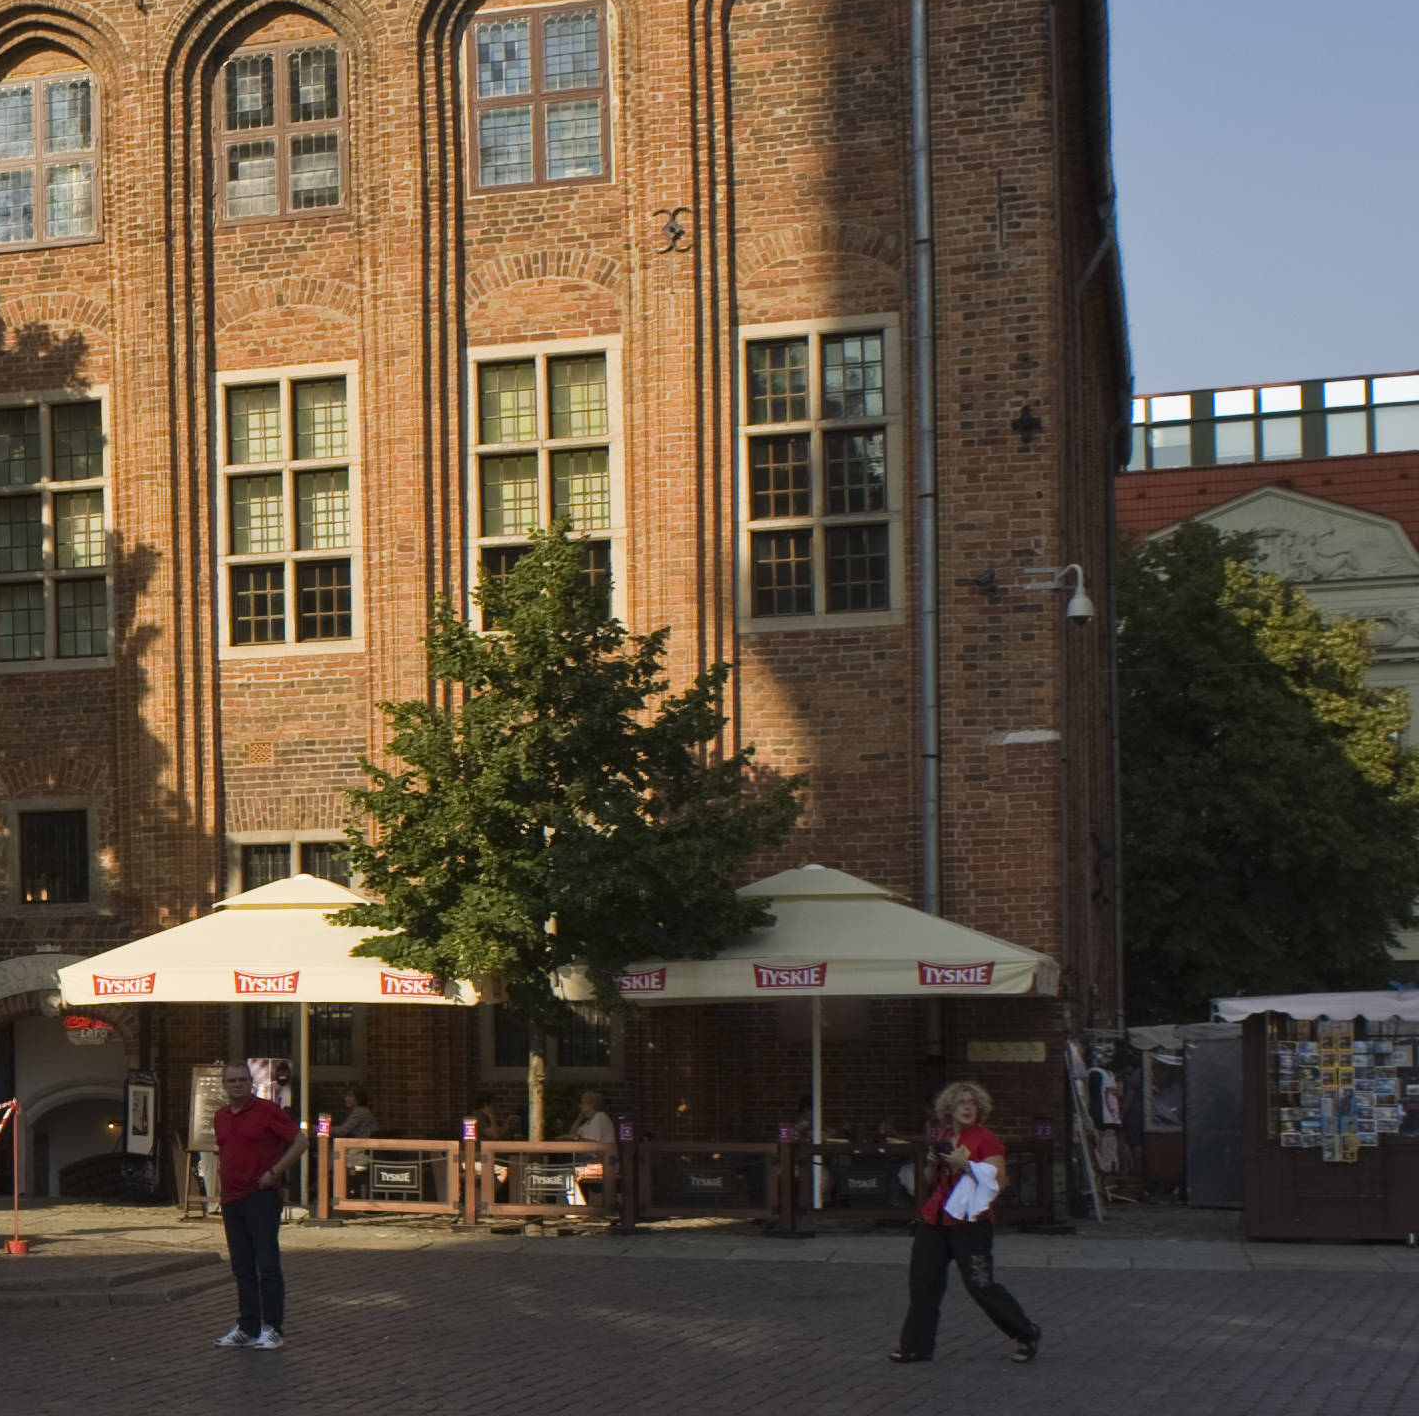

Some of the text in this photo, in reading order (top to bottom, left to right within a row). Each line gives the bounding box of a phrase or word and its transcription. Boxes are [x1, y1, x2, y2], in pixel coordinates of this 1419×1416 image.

[611, 971, 661, 989] YSKIE
[758, 968, 822, 986] TYSKIE
[923, 966, 988, 984] TYSKIE
[96, 977, 152, 994] TYSKIE
[236, 976, 297, 992] TYSKIE
[380, 1171, 410, 1183] TYSKIE
[531, 1174, 565, 1186] TYSKIE
[689, 1176, 724, 1187] TYSKIE
[847, 1177, 878, 1188] TYSKIE
